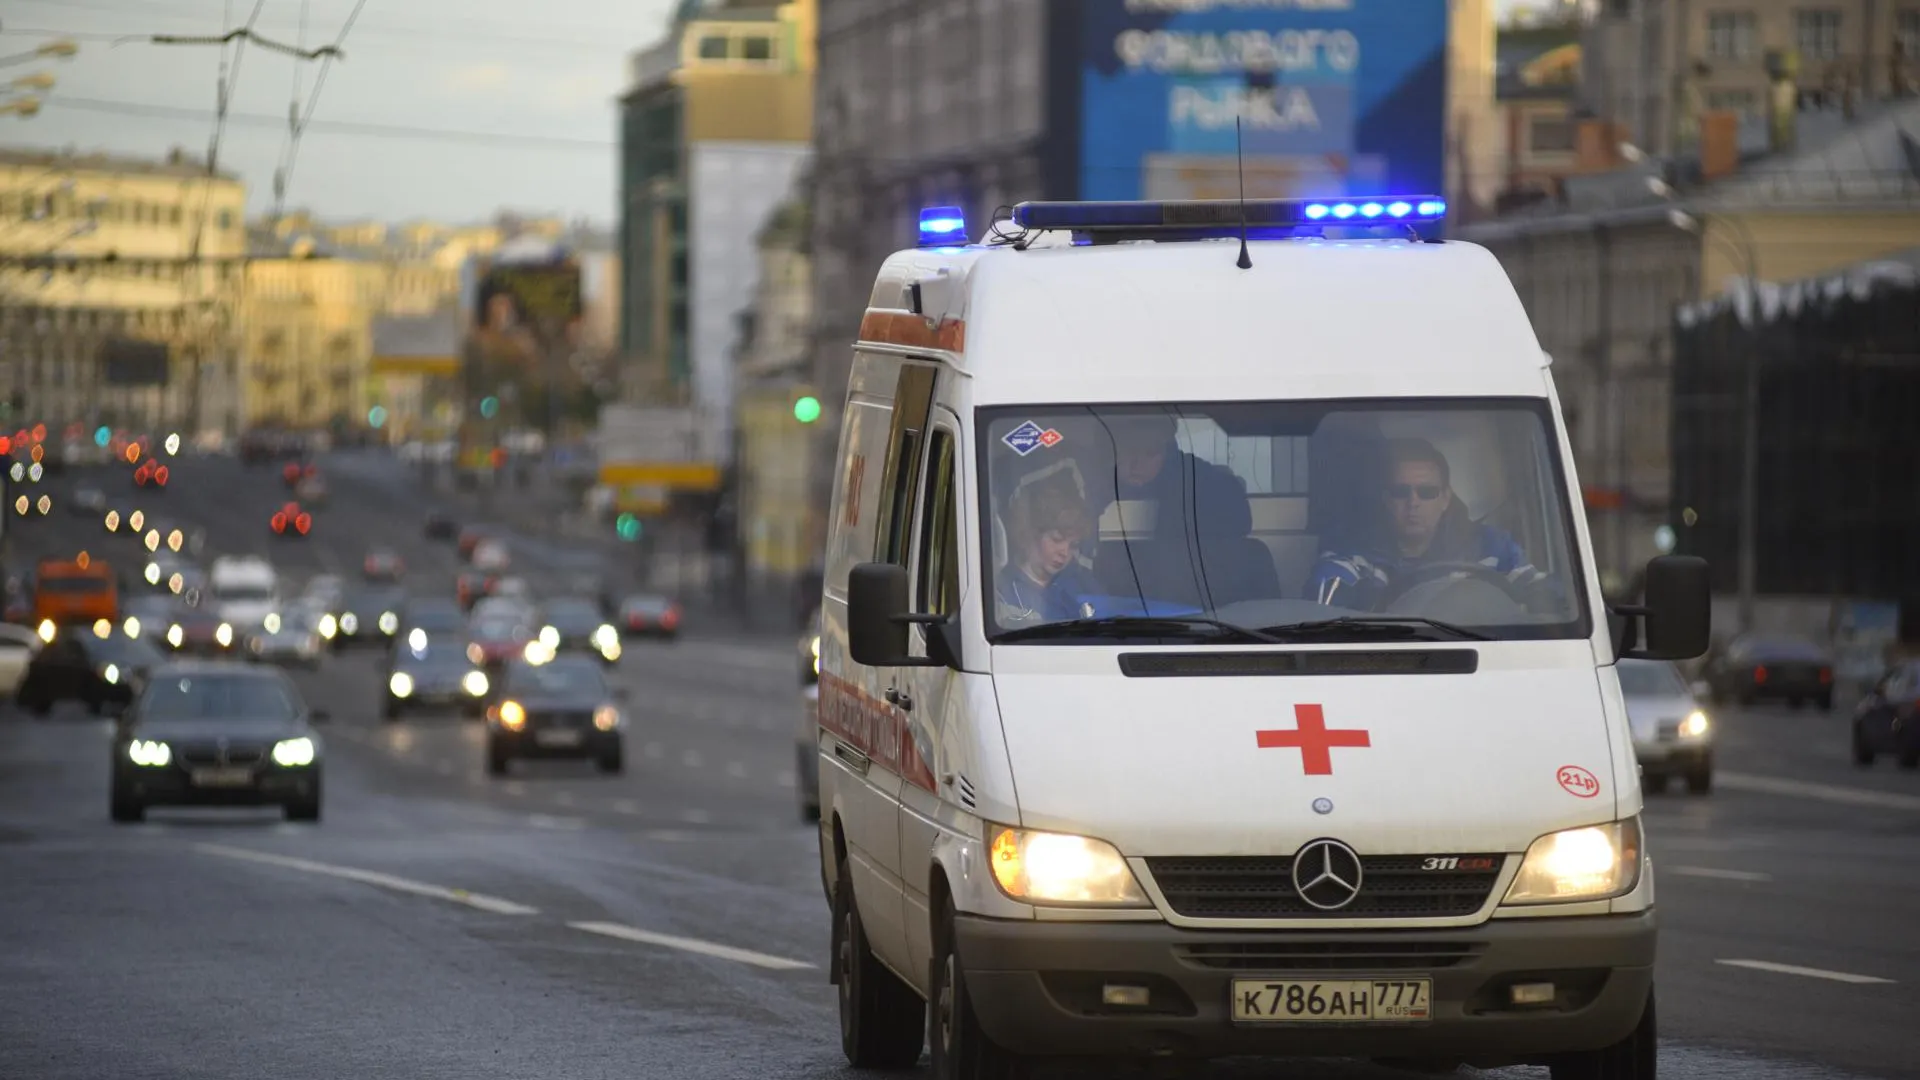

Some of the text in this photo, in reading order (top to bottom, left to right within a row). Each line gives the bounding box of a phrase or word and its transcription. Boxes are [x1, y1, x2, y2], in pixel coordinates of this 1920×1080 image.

[1170, 86, 1321, 131] РЫНКА
[1244, 982, 1421, 1015] К786АН 777
[1386, 1006, 1409, 1015] RUS
